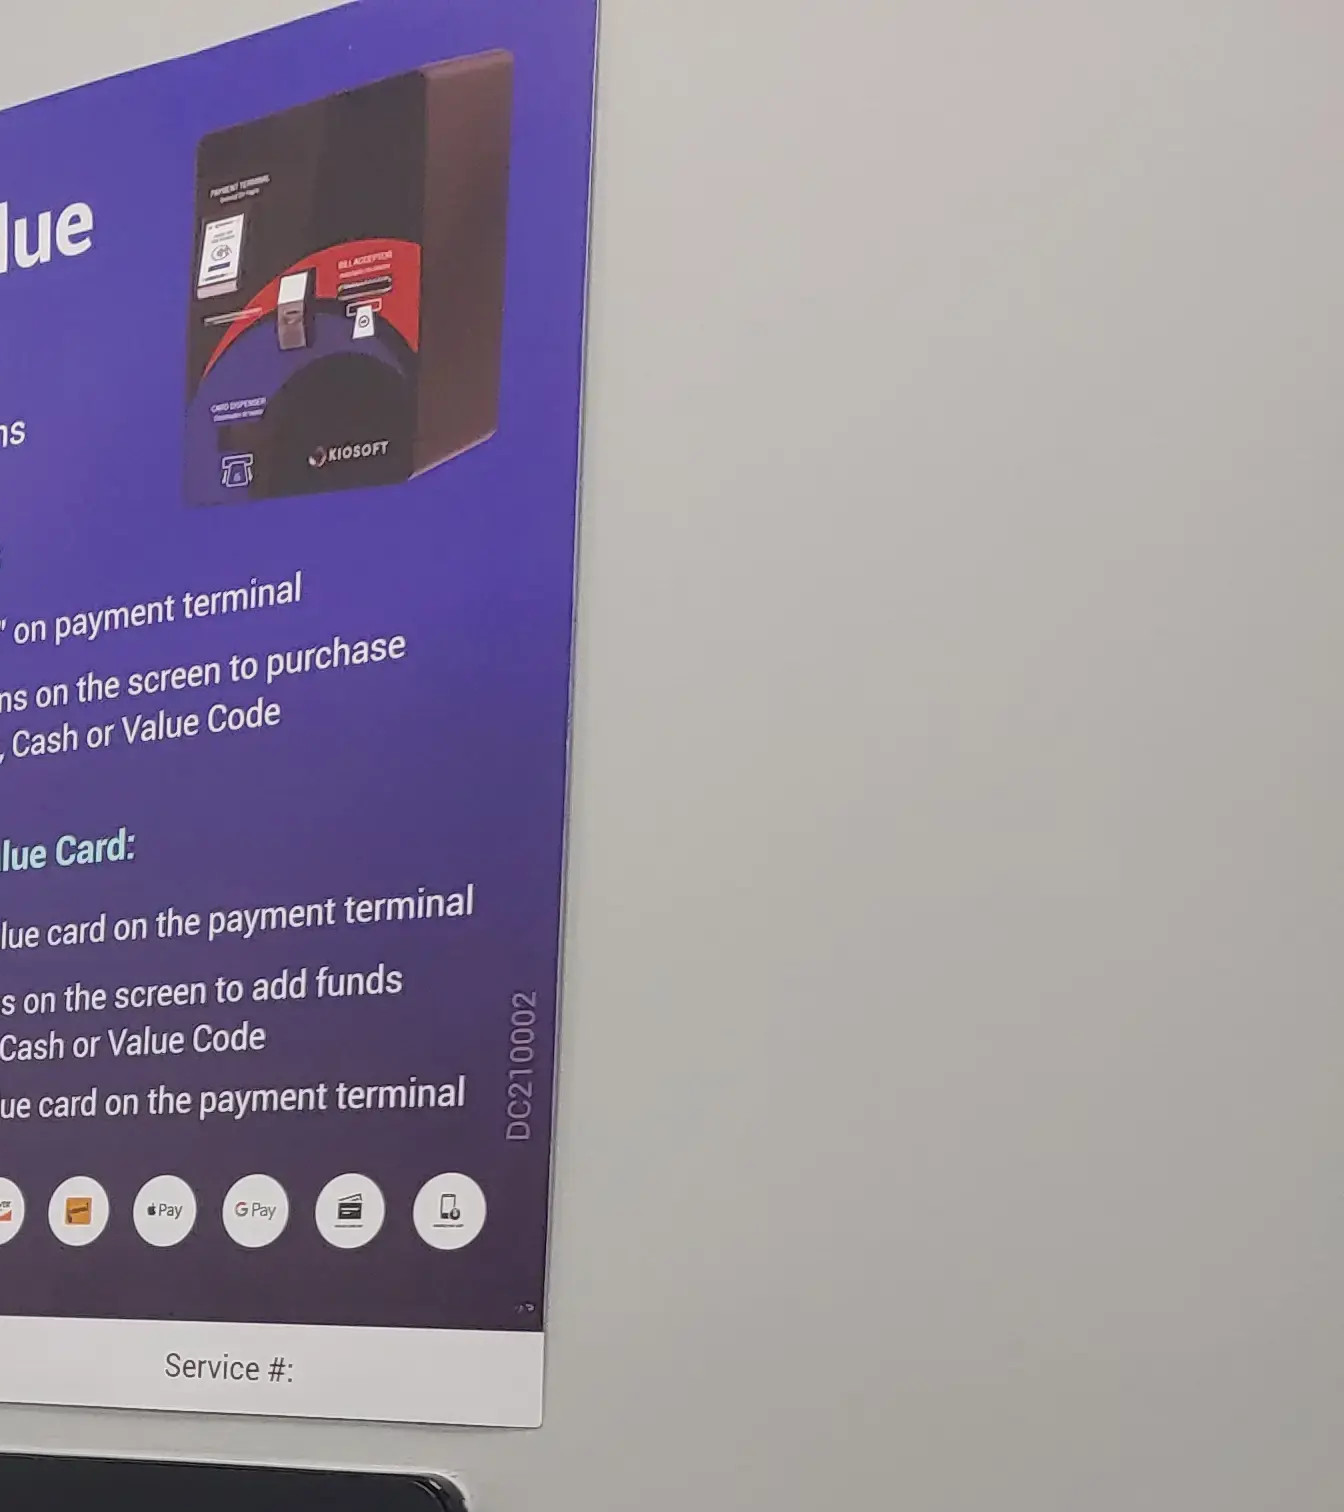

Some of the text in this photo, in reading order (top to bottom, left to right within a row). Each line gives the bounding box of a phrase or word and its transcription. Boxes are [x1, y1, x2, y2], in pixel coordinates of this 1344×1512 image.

[328, 440, 389, 462] KIOSOFT
[14, 618, 46, 644] on
[55, 597, 174, 642] payment
[183, 573, 302, 620] terminal
[36, 682, 68, 708] on
[76, 670, 119, 702] the
[128, 659, 220, 693] screen
[230, 655, 258, 683] to
[267, 632, 406, 682] purchase
[13, 724, 79, 760] Cash
[87, 722, 114, 750] or
[122, 708, 198, 746] Value
[207, 698, 281, 735] Code
[55, 827, 135, 866] Card:
[46, 911, 105, 947] card
[114, 915, 148, 942] on
[156, 906, 201, 939] the
[209, 898, 335, 938] payment
[345, 884, 473, 921] terminal
[23, 985, 56, 1014] on
[64, 977, 107, 1011] the
[115, 974, 207, 1006] screen
[216, 970, 245, 999] to
[253, 965, 307, 998] add
[316, 962, 403, 998] funds
[0, 1026, 64, 1061] Cash
[72, 1031, 100, 1057] or
[108, 1021, 184, 1057] Value
[193, 1019, 265, 1053] Code
[506, 990, 536, 1141] DC210002
[252, 1202, 276, 1220] Pay
[166, 1352, 294, 1384] Service #:
